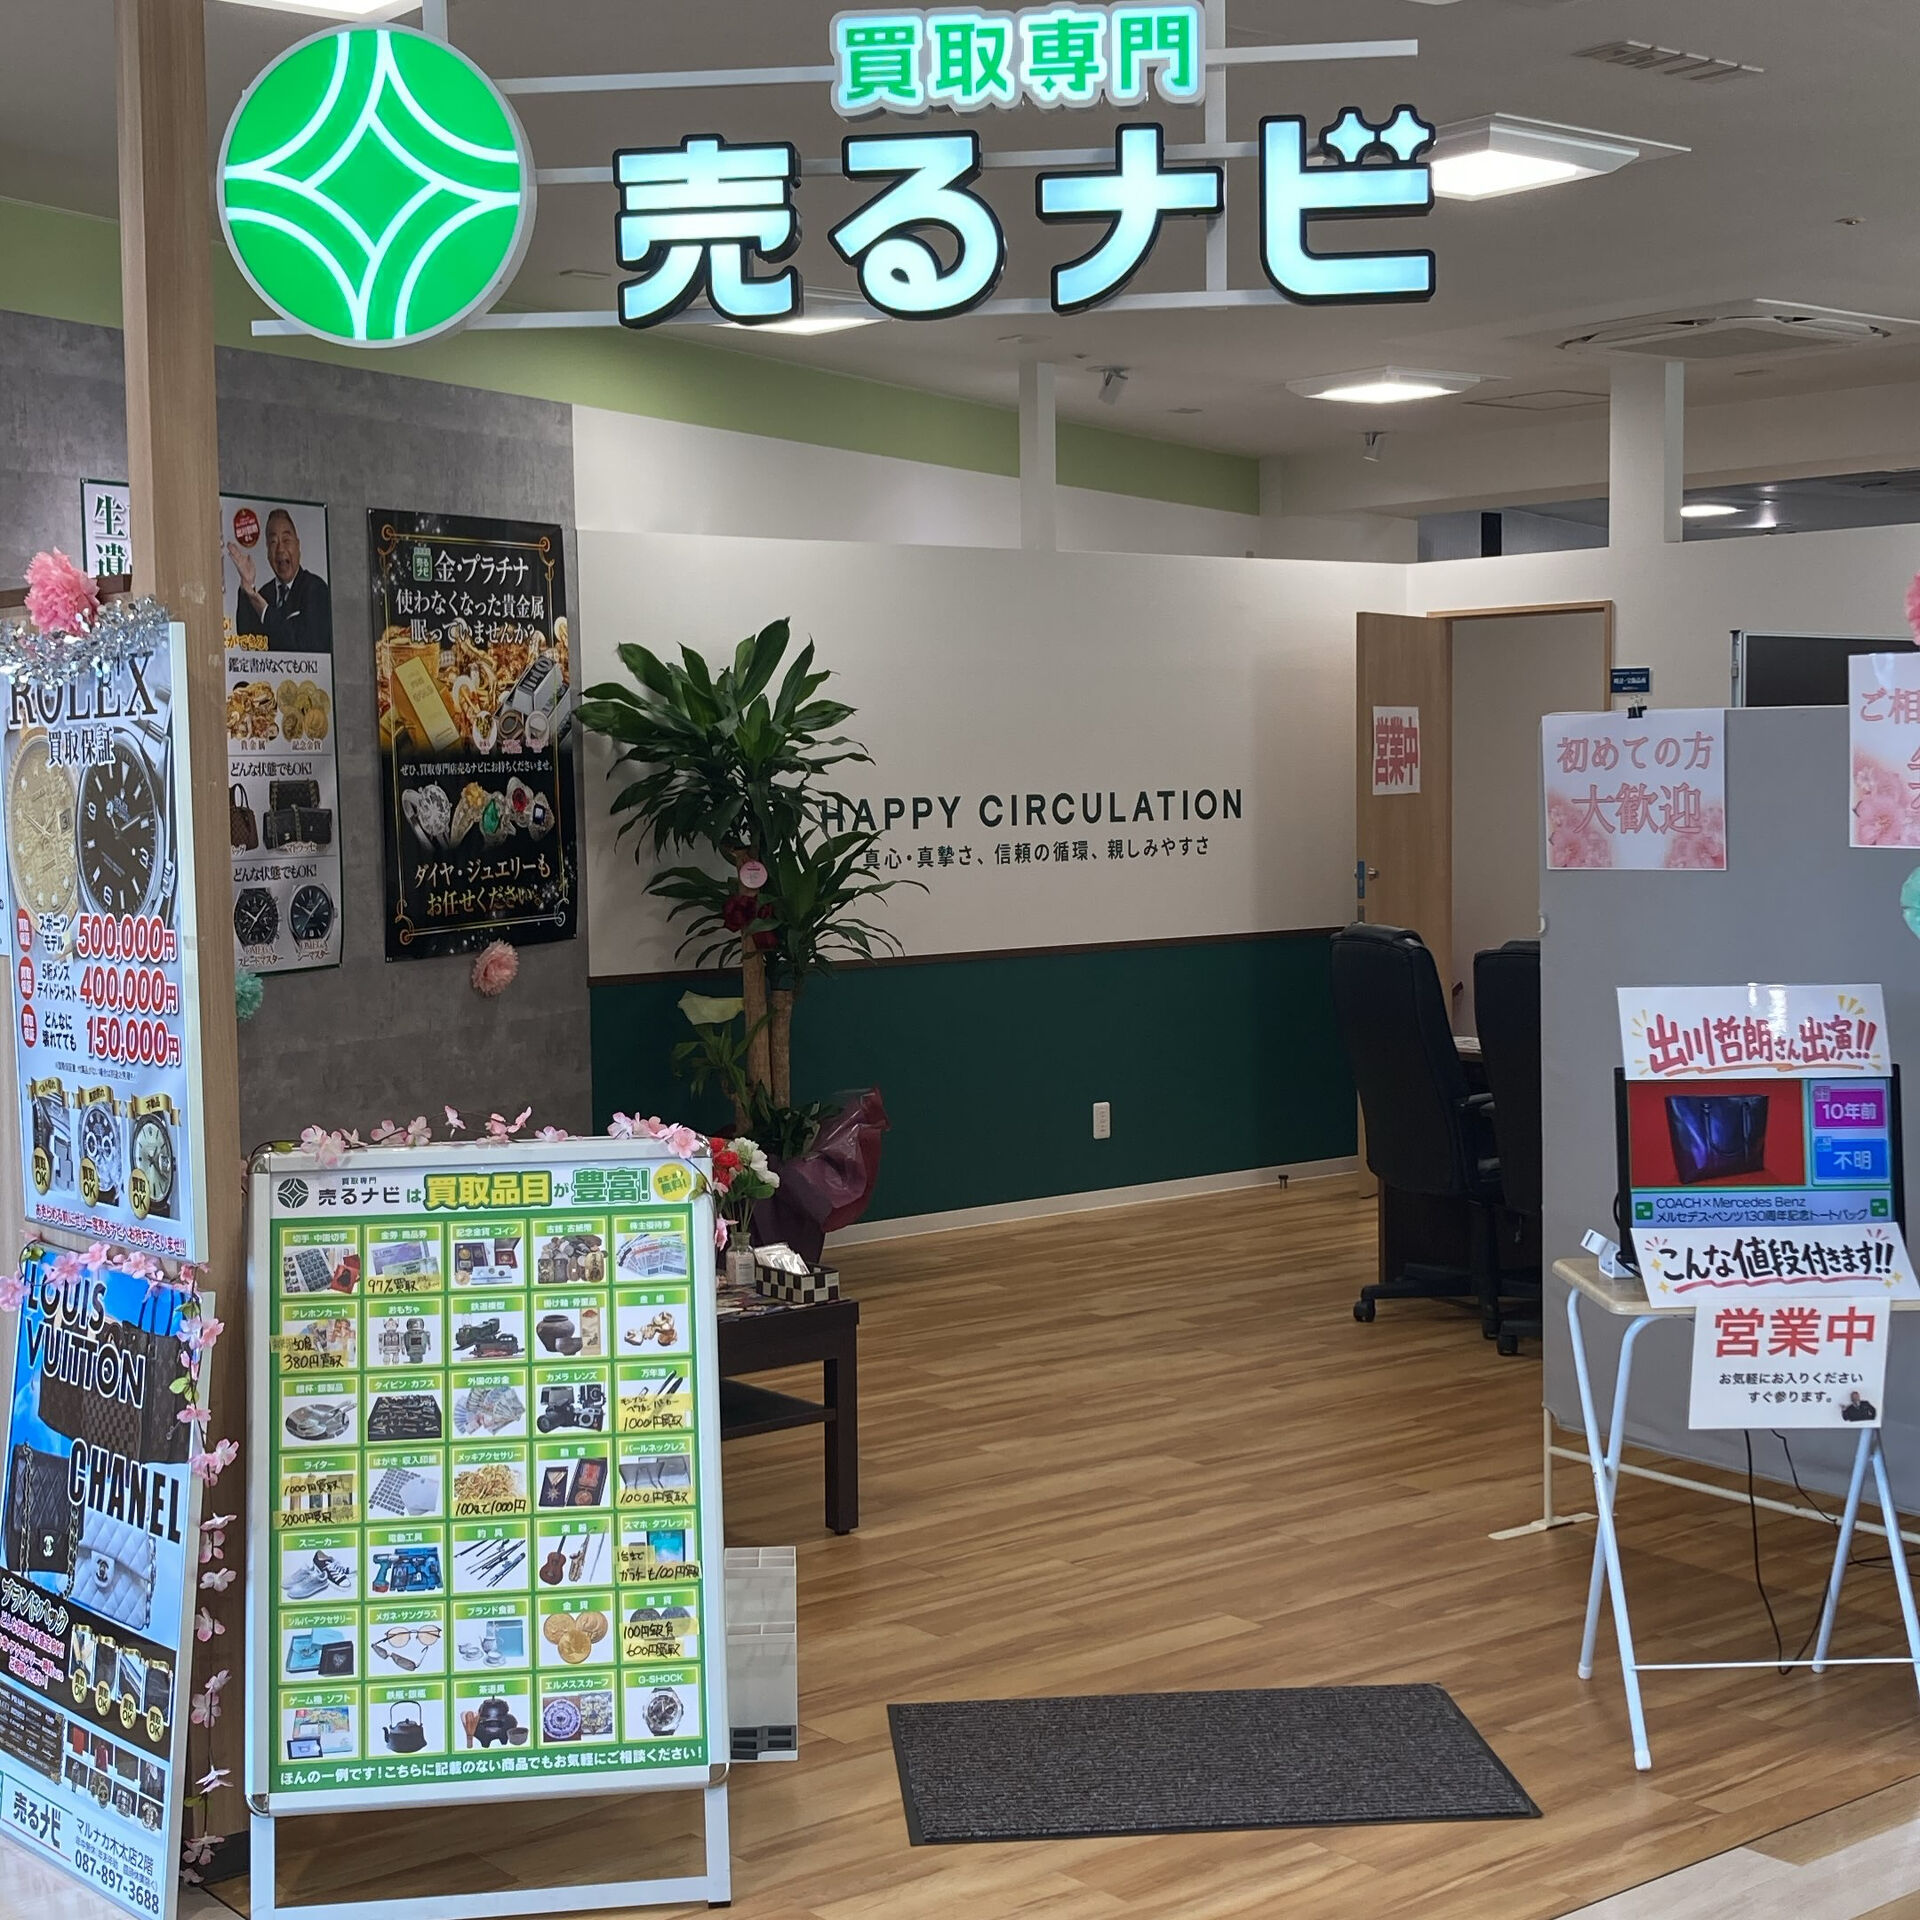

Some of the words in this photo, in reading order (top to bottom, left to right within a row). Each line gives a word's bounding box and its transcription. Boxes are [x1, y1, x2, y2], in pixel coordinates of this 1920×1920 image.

[838, 10, 1202, 106] 買取専門
[615, 108, 1436, 326] 売るナビ
[94, 494, 131, 537] 生
[95, 543, 132, 576] 遺
[434, 550, 529, 586] 金・プラチナ
[396, 588, 544, 620] 使わなくなった貴金属
[410, 618, 535, 645] 眠っていませんか?
[9, 650, 158, 726] ROLEX
[47, 728, 115, 767] 買取保証
[1375, 716, 1418, 786] 営業中
[1557, 730, 1715, 774] 初めての方
[819, 795, 963, 833] HAPPY
[978, 788, 1243, 829] CIRCULATION
[1571, 782, 1703, 834] 大歓迎
[414, 853, 551, 889] ダイヤ・ジュエリーも
[77, 914, 177, 963] 500,000円
[80, 966, 179, 1013] 400,000円
[86, 1016, 180, 1065] 150,000円
[1645, 1012, 1877, 1074] 出川哲朗さん出演!!
[1822, 1102, 1877, 1120] 10年前
[1833, 1150, 1872, 1170] 不明
[1775, 1197, 1806, 1208] Benz
[1659, 1237, 1894, 1282] こんな値段付きます!!
[27, 1261, 106, 1333] LOUIS
[388, 1305, 420, 1315] おもちゃ
[1715, 1306, 1875, 1358] 営業中
[26, 1316, 146, 1408] VUITTON
[1718, 1371, 1863, 1386] お気軽にお入りください
[1747, 1390, 1832, 1405] すぐ参ります。
[304, 1459, 336, 1470] ライター
[69, 1439, 181, 1545] CHANEL
[299, 1537, 342, 1547] スニーカー
[638, 1674, 684, 1684] G-SHOCK
[74, 1849, 160, 1915] 087-897-3688
